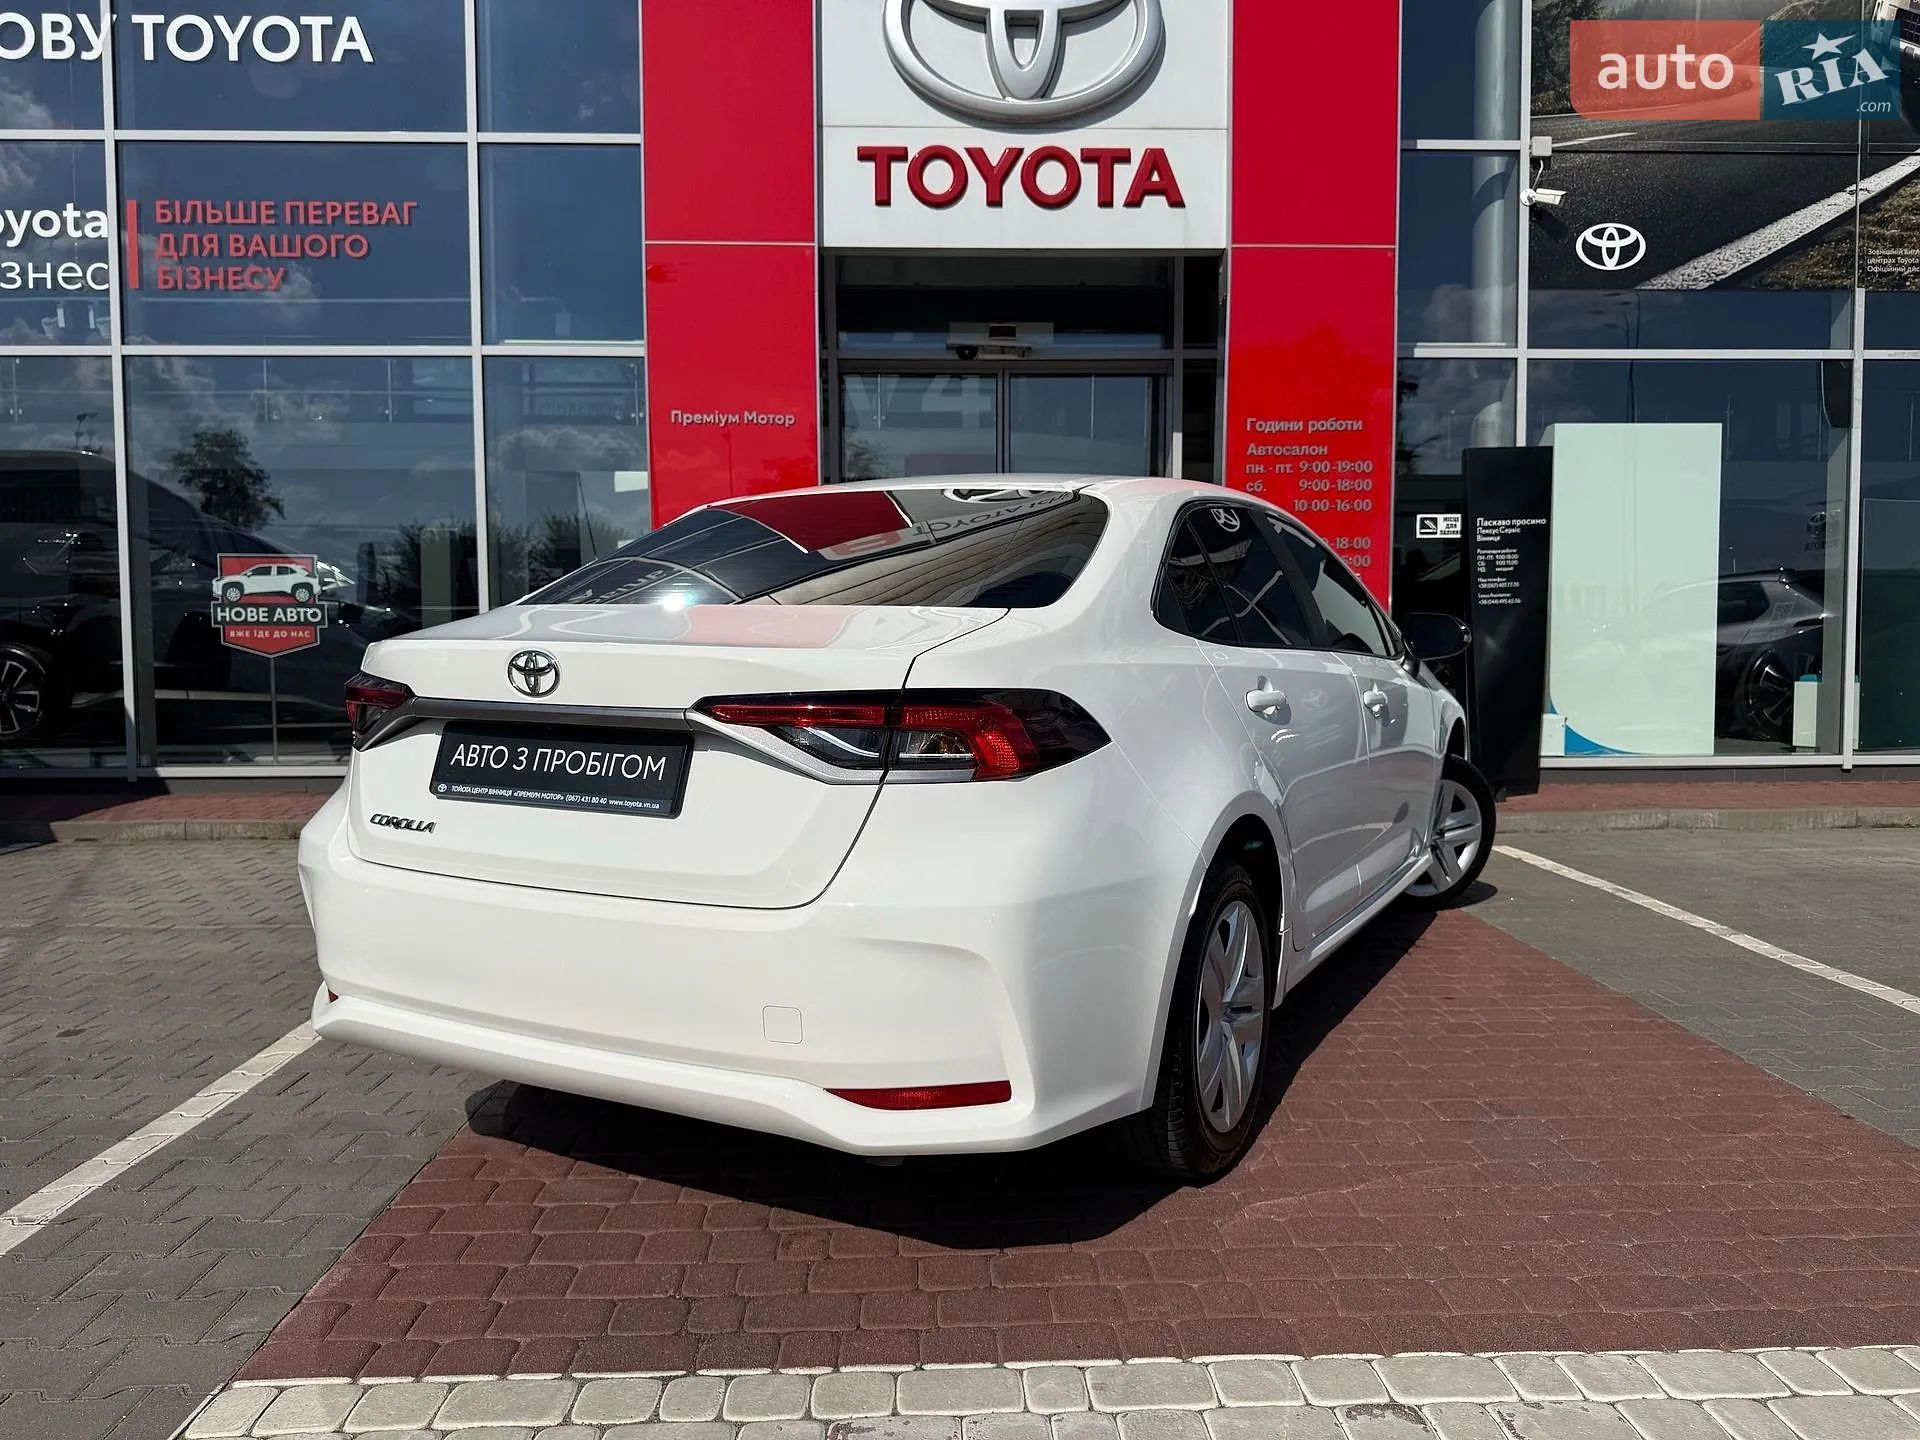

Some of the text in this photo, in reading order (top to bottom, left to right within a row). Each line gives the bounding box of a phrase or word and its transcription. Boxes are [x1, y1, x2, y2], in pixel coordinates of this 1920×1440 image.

[131, 14, 374, 63] TOYOTA
[857, 145, 1186, 209] TOYOTA
[154, 199, 418, 226] БІЛЬШЕ ПЕРЕВАГ
[155, 233, 369, 259] ДЛЯ ВАШОГО
[156, 266, 286, 291] БІЗНЕСУ
[671, 410, 795, 427] Преміум Мотор
[1246, 417, 1362, 434] Години роботи
[1246, 443, 1328, 456] Автосалон
[1512, 518, 1547, 527] просимо
[217, 607, 322, 622] НОВЕ АВТО
[254, 629, 270, 638] ЇДЕ
[273, 630, 288, 638] ДО
[291, 630, 311, 638] НАС
[450, 743, 667, 781] АВТО З ПРОБІГОМ
[471, 787, 488, 795] ЦЕНТР
[566, 794, 580, 803] (067)
[599, 797, 607, 805] 40
[609, 799, 660, 809] www.toyota.vn.ua
[370, 813, 436, 833] COROLLA
